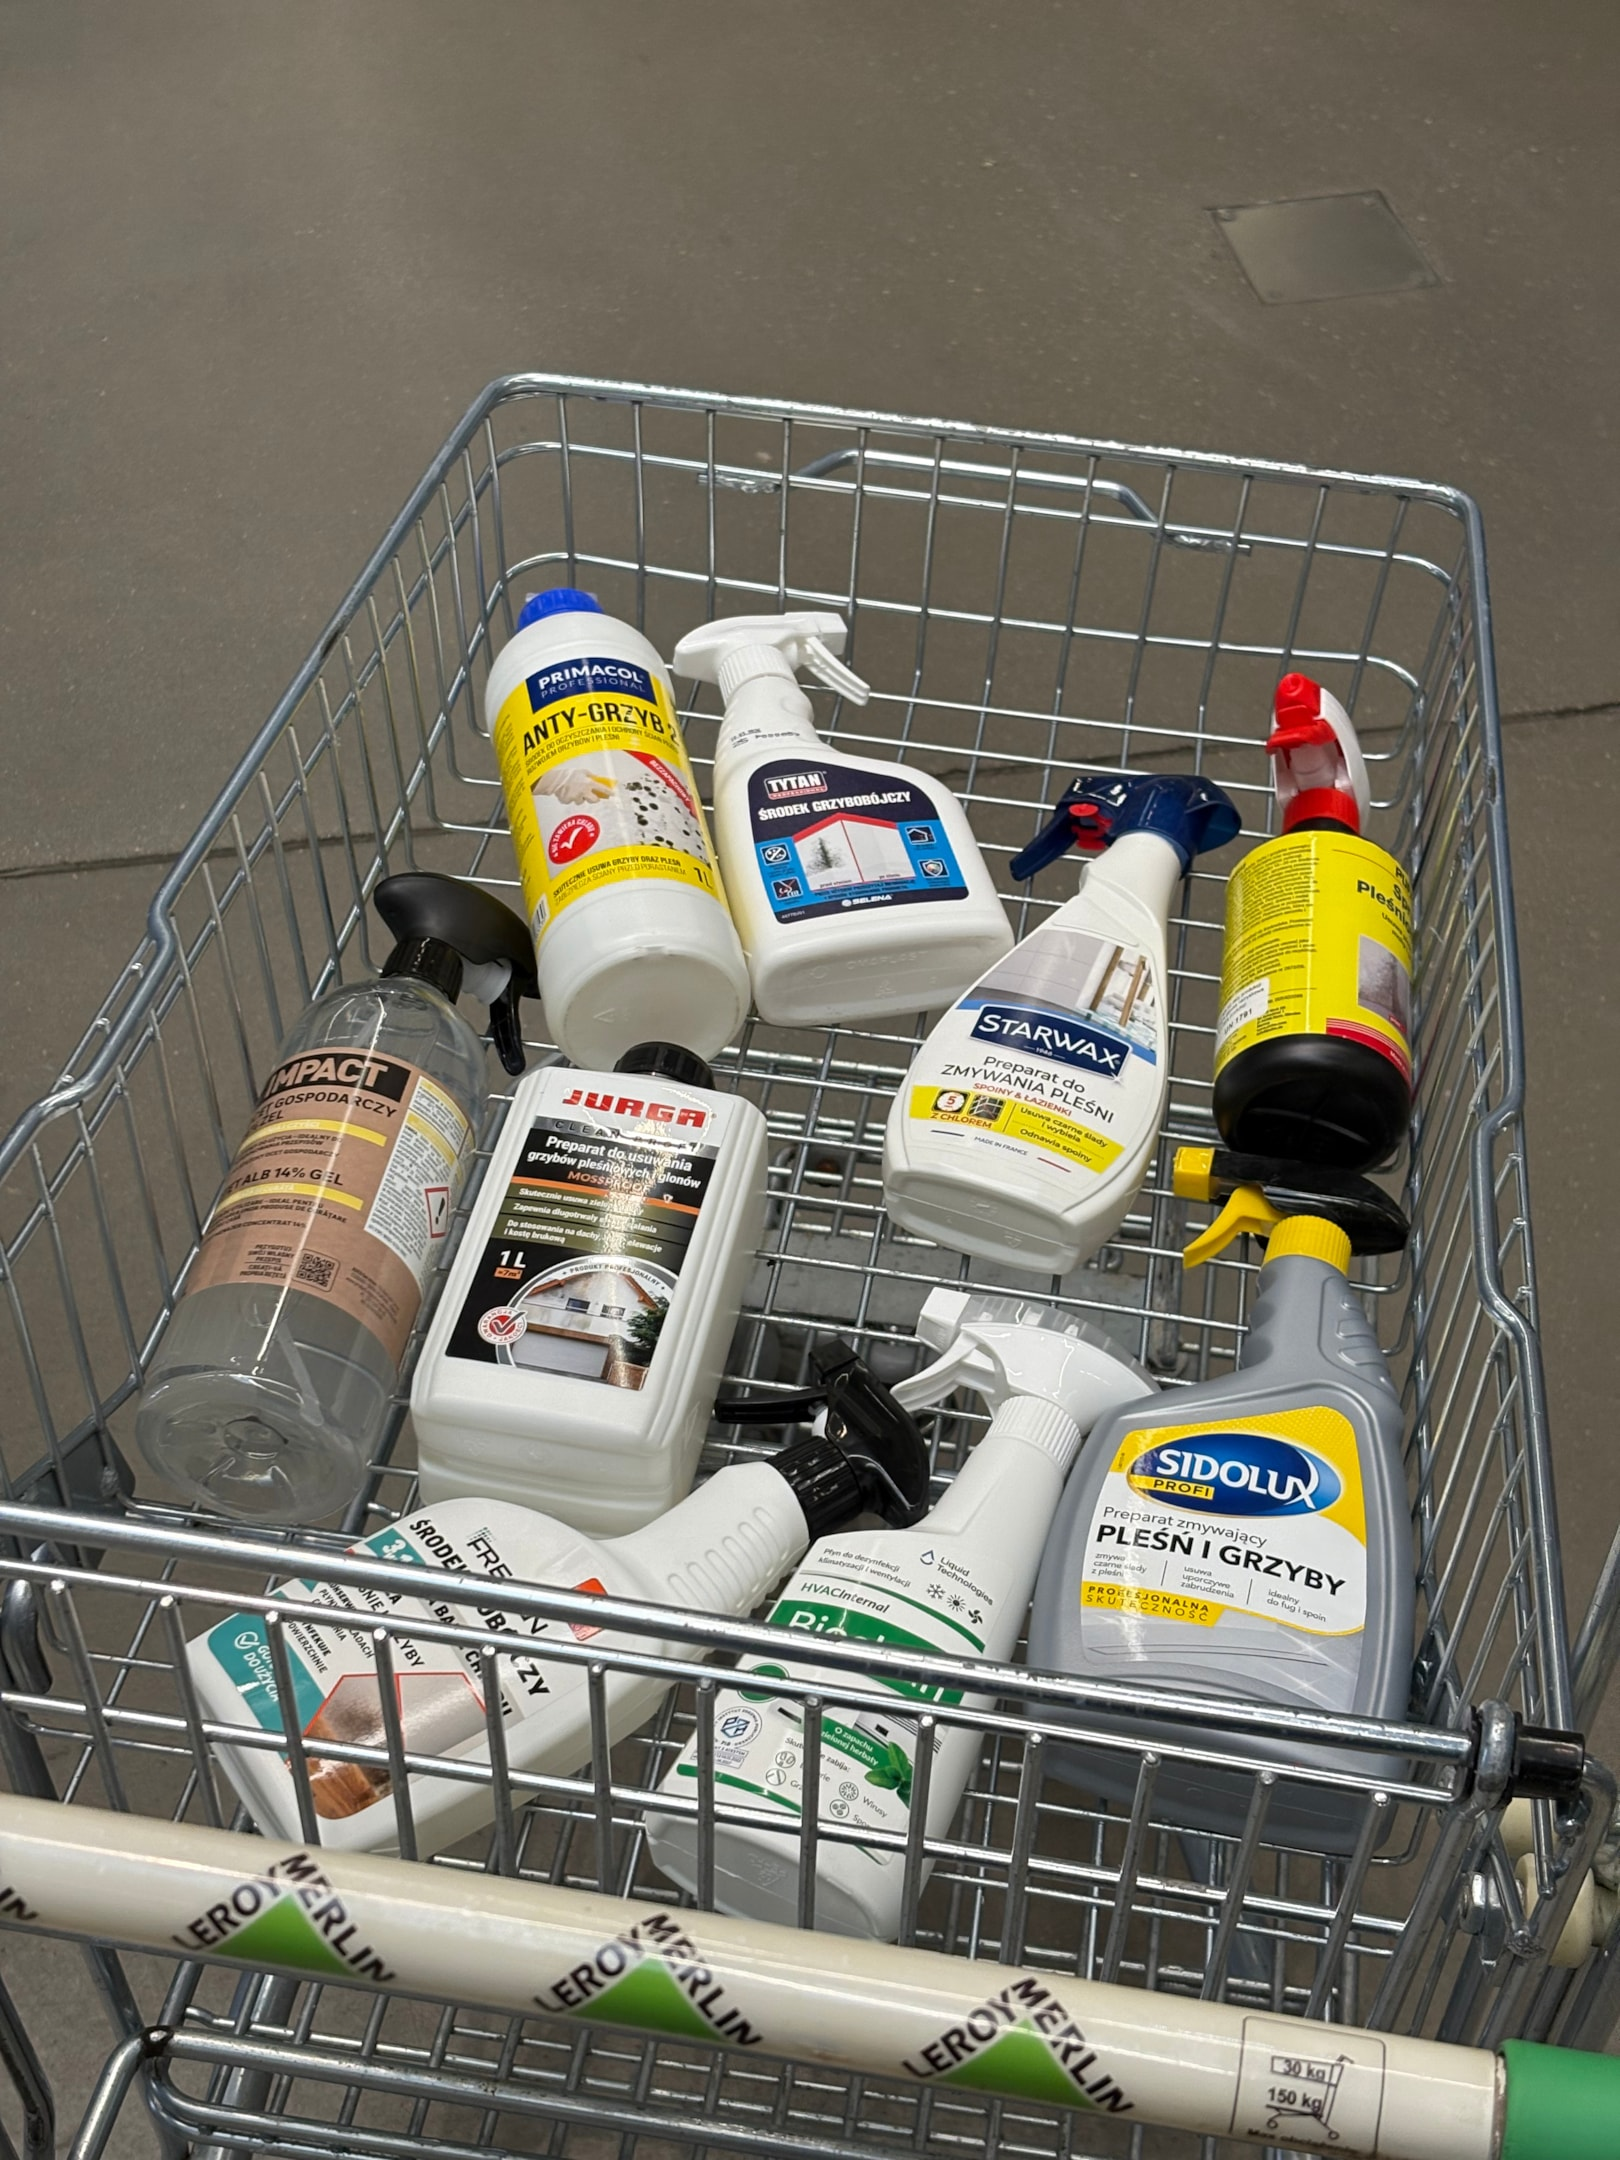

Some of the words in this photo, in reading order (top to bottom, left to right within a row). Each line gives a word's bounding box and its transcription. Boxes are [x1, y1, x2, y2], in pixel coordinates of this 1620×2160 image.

[538, 664, 643, 690] PRIMACOL
[541, 677, 647, 698] PROFESSIONAL
[524, 702, 665, 757] ANTY-GRZYB
[767, 773, 822, 793] TYTAN
[758, 803, 810, 821] ŚRODEK
[812, 791, 911, 813] GRZYBOBÓJCZY
[852, 894, 893, 905] SELENA
[978, 1013, 1122, 1071] STARWAX
[264, 1057, 389, 1098] IMPACT
[983, 1055, 1060, 1084] Preparat
[1062, 1078, 1085, 1094] do
[274, 1091, 397, 1118] GOSPODARCZY
[941, 1064, 1044, 1095] ZMYWANIA
[1050, 1087, 1114, 1124] PLEŚNI
[947, 1095, 957, 1105] 5
[973, 1082, 1012, 1097] SPOINY
[1023, 1094, 1072, 1117] ŁAZIENKI
[562, 1089, 707, 1128] JURGA
[930, 1112, 939, 1120] Z
[940, 1113, 992, 1129] CHLOREM
[1020, 1107, 1051, 1122] Usuwa
[1053, 1119, 1082, 1136] czarne
[1084, 1130, 1108, 1148] ślady
[1047, 1124, 1081, 1144] wybiela
[546, 1136, 605, 1157] Preparat
[607, 1146, 625, 1159] do
[628, 1152, 692, 1172] usuwania
[974, 1136, 993, 1146] MADE
[1002, 1144, 1028, 1156] FRANCE
[1019, 1128, 1061, 1148] Odnawia
[1062, 1145, 1092, 1163] spoiny
[242, 1169, 272, 1184] ALB
[275, 1167, 305, 1179] 14%
[309, 1168, 344, 1186] GEL
[527, 1150, 577, 1168] grzybów
[578, 1158, 650, 1179] pleśniowych
[658, 1172, 701, 1189] glonów
[1153, 1478, 1211, 1498] PROFI
[1156, 1448, 1319, 1510] SIDOLUX
[1103, 1506, 1175, 1528] Preparat
[1177, 1519, 1268, 1548] zmywający
[823, 1547, 841, 1557] Płyn
[1093, 1560, 1122, 1569] czarne
[1095, 1553, 1125, 1562] zmywa
[1096, 1522, 1195, 1556] PLEŚŃ
[1202, 1539, 1212, 1559] I
[1218, 1545, 1346, 1597] GRZYBY
[870, 1569, 911, 1588] wentylacji
[940, 1556, 970, 1577] Liquid
[1184, 1566, 1213, 1577] usuwa
[937, 1563, 994, 1606] Technologies
[1180, 1581, 1235, 1599] zabrudzenia
[1182, 1574, 1231, 1590] uporczywe
[801, 1582, 890, 1614] HVACInternal
[1086, 1594, 1208, 1622] SKUTECZNOŚĆ
[1088, 1585, 1209, 1613] PROFESJONALNA
[1266, 1597, 1280, 1607] do
[1280, 1600, 1298, 1615] fug
[1302, 1609, 1327, 1623] spoin
[1268, 1588, 1300, 1605] idealny
[243, 1652, 261, 1668] DO
[820, 1730, 849, 1751] zielonej
[850, 1744, 879, 1767] herbaty
[834, 1726, 843, 1735] O
[843, 1731, 874, 1752] zapachu
[863, 1796, 888, 1818] Wirusy
[172, 1864, 283, 1951] LEROY
[280, 1851, 398, 1984] MERLIN
[533, 1925, 645, 2014] LEROY
[641, 1912, 764, 2047] MERLIN
[902, 1989, 1017, 2078] LEROY
[1010, 1976, 1135, 2113] MERLIN
[1283, 2059, 1302, 2075] 30
[1307, 2063, 1326, 2081] kg
[1268, 2087, 1297, 2105] 150
[1302, 2092, 1322, 2114] kg
